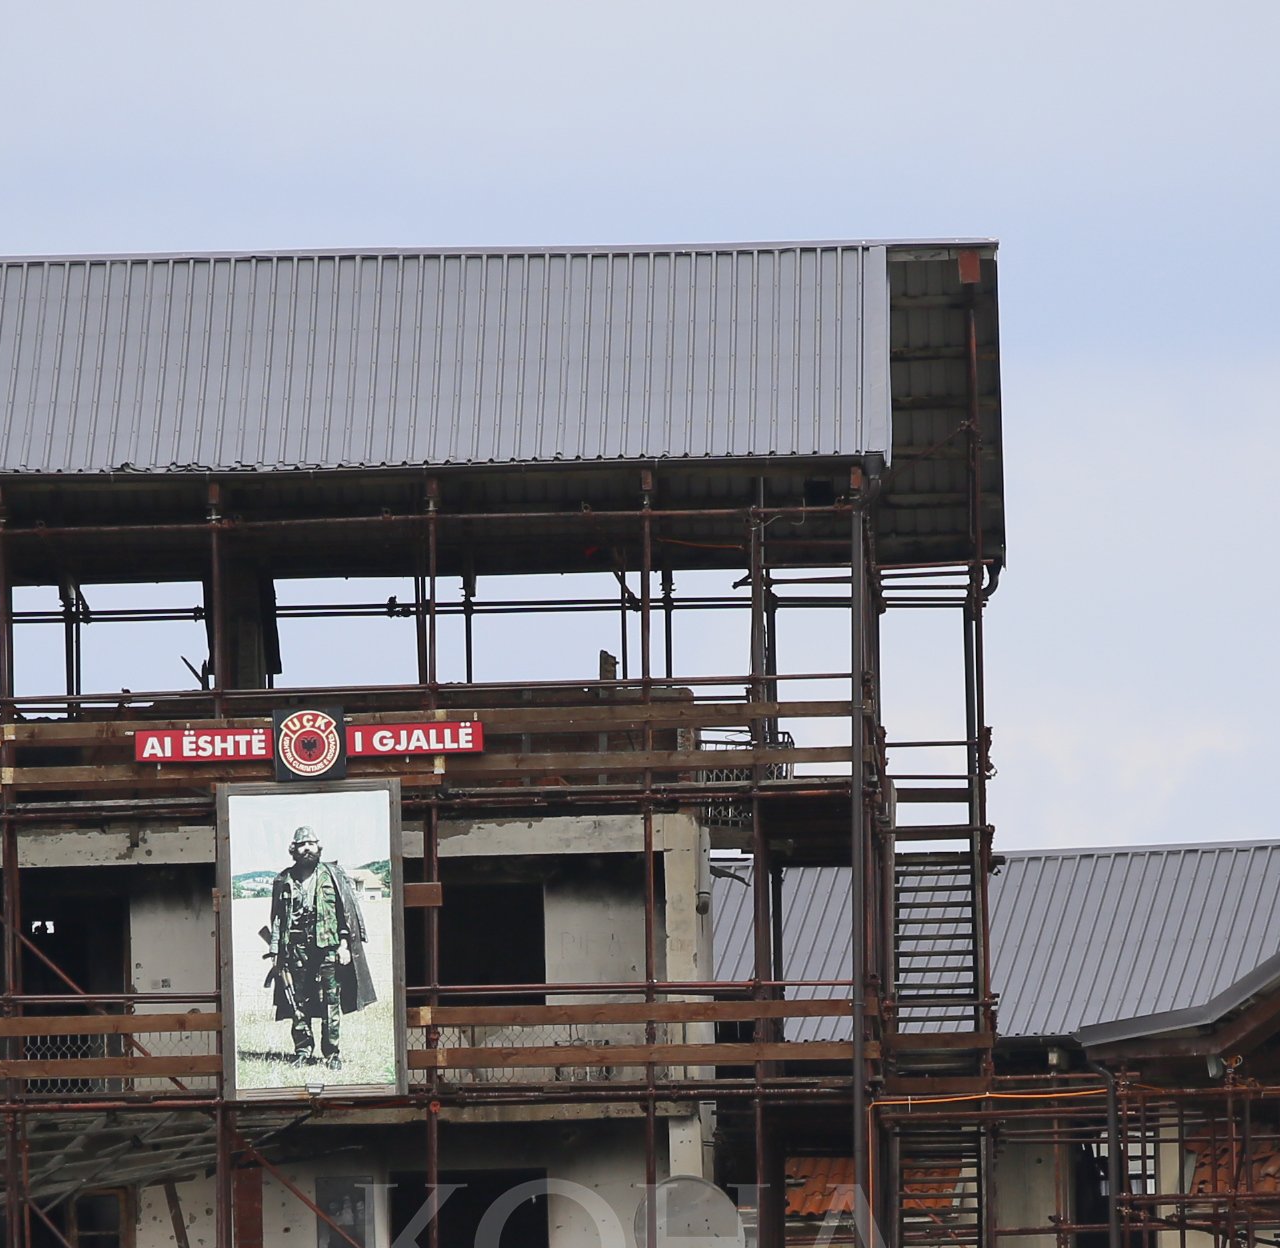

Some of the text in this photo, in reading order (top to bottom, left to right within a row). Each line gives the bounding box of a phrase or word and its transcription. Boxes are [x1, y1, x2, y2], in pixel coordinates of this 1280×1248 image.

[142, 721, 473, 758] AI ËSHTË I GJALLË
